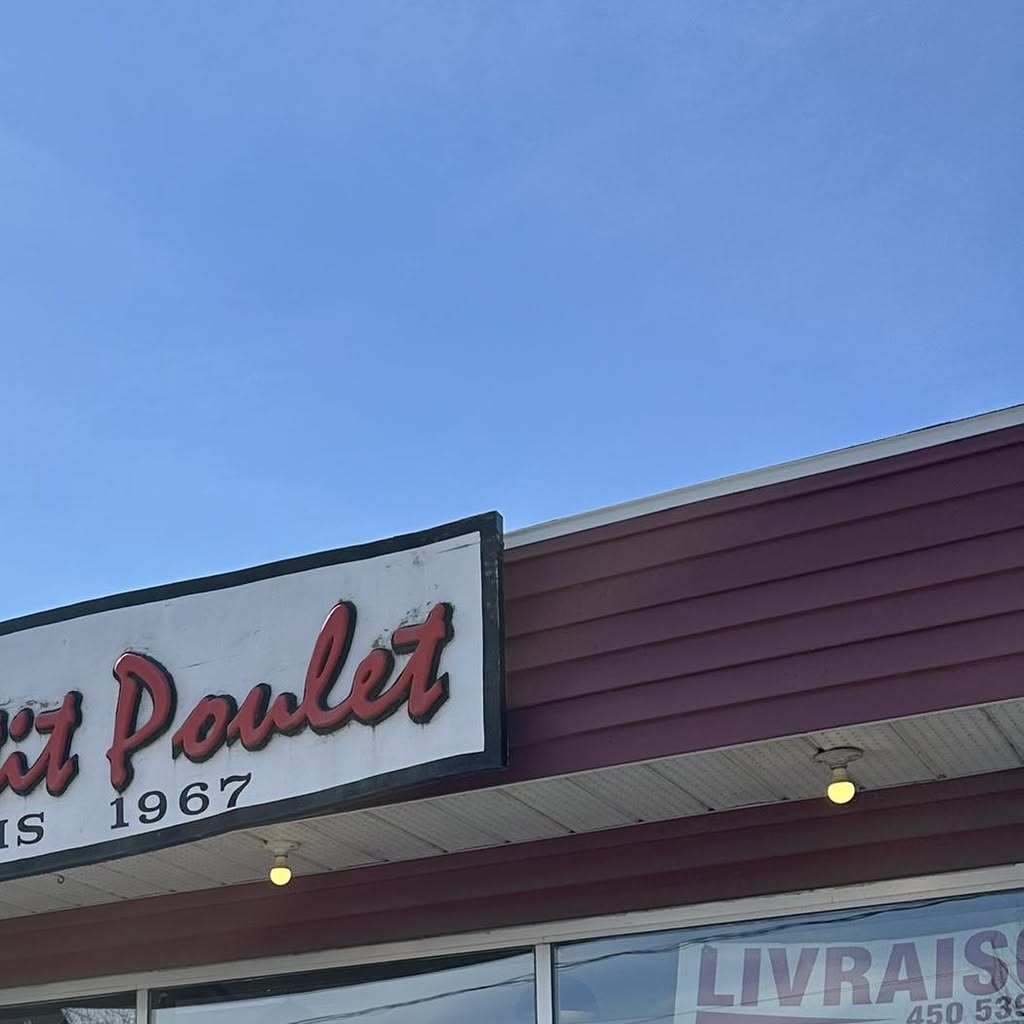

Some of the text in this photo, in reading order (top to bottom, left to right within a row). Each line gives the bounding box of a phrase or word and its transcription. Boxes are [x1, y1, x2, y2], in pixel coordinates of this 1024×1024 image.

[106, 600, 454, 792] Poulet
[109, 772, 252, 830] 1967
[696, 928, 1024, 1007] LIVRAIS
